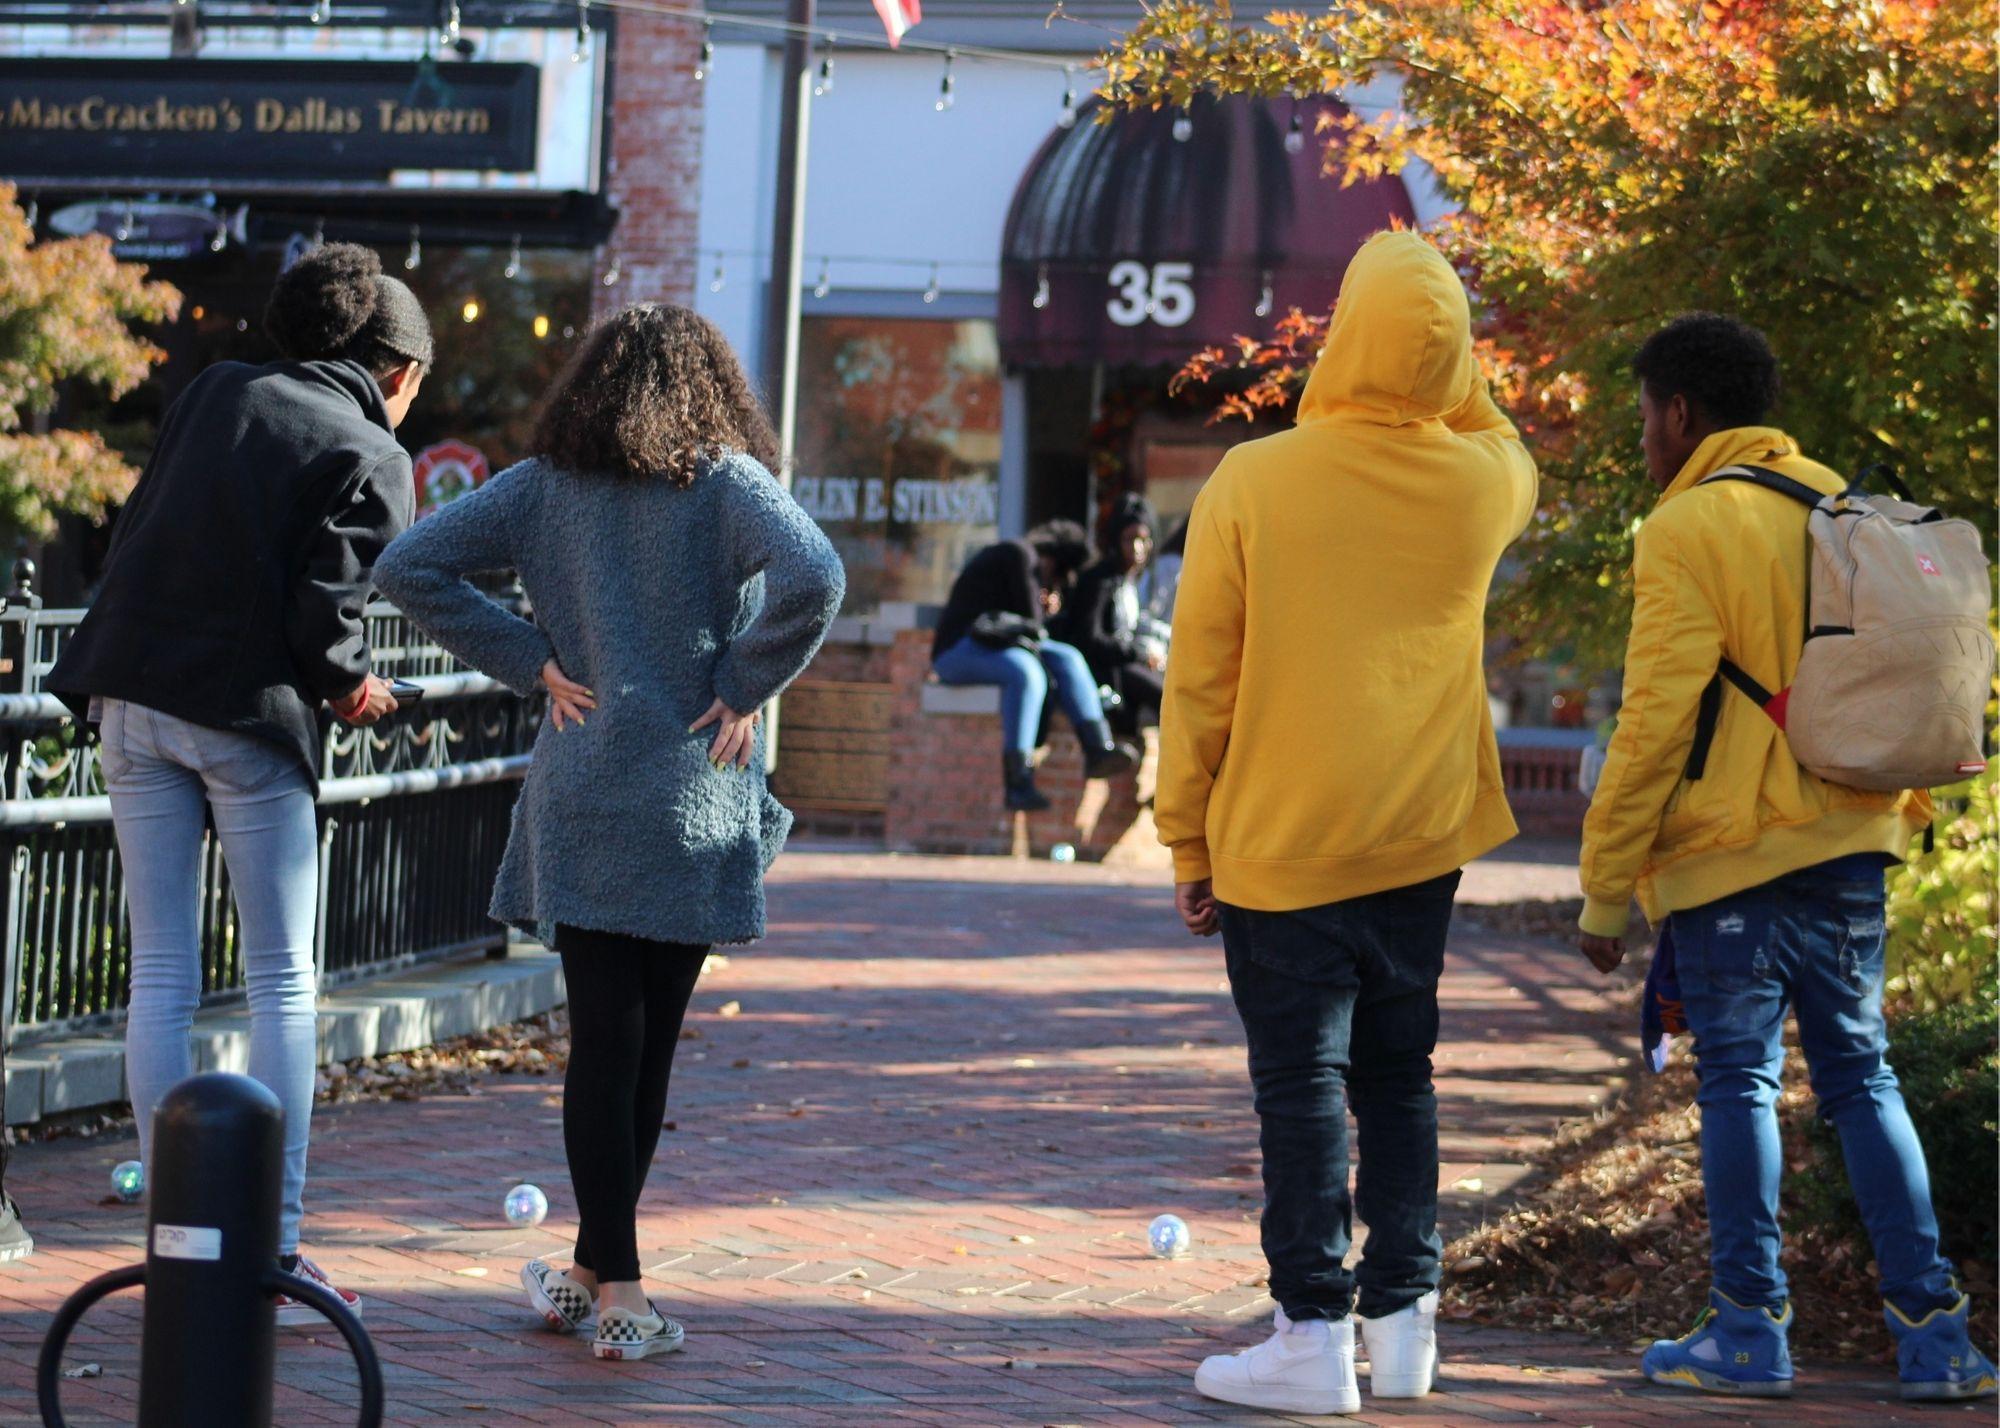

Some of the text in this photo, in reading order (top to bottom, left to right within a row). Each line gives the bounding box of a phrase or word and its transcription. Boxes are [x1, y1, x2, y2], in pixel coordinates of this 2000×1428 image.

[10, 95, 491, 134] MacCracken's Dallas Tavern
[1106, 259, 1196, 328] 35
[892, 478, 998, 524] STINSON
[1734, 1351, 1749, 1364] 23
